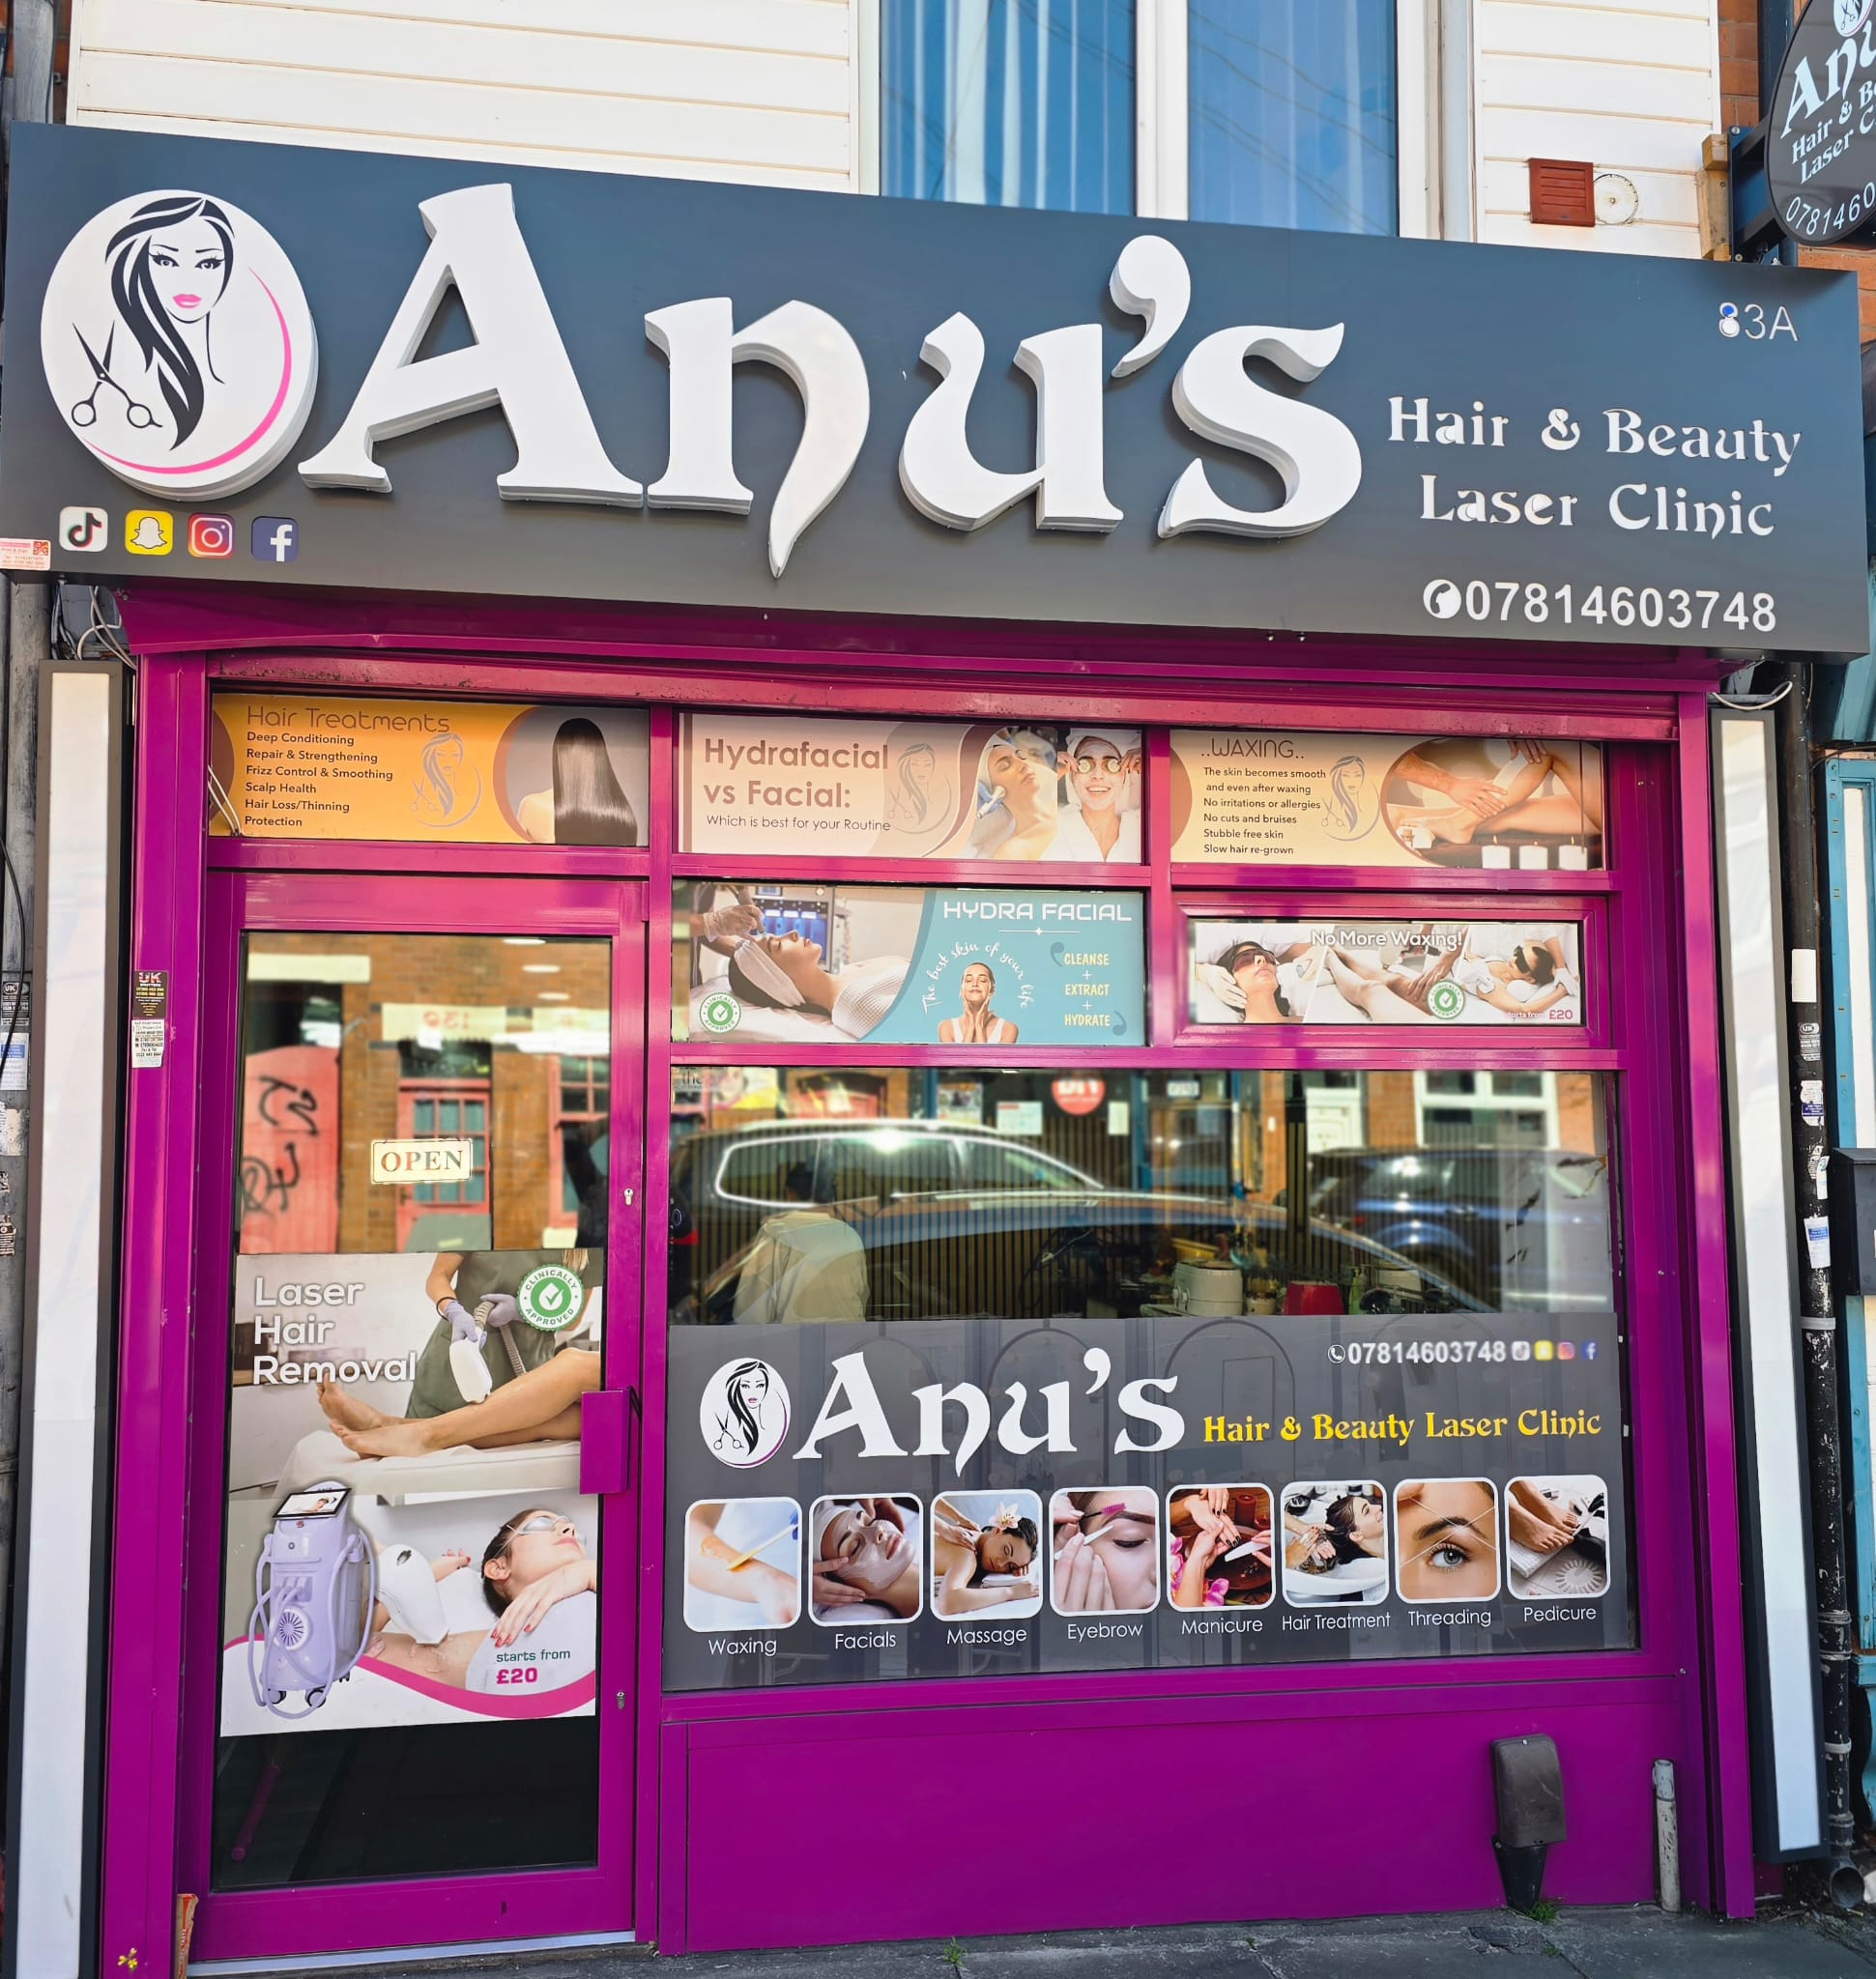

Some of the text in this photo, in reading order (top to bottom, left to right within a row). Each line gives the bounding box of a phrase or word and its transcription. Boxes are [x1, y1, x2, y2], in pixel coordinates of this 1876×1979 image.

[1792, 118, 1833, 163] Hair
[1838, 100, 1853, 125] &
[1800, 129, 1854, 185] Laser
[1786, 182, 1875, 236] 0781460
[1719, 301, 1799, 342] 83A
[298, 183, 1362, 578] Anu's
[1388, 396, 1802, 477] Hair & Beauty
[1421, 473, 1775, 540] Laser Clinic
[1464, 580, 1777, 633] 07814603748
[247, 704, 450, 733] Hair Treatments
[246, 731, 355, 747] Deep Conditioning
[246, 748, 378, 764] Repair & Strengthening
[705, 737, 888, 770] Hydrafacial
[245, 764, 393, 782] Frizz Control & Smoothing
[1203, 766, 1326, 779] The skin becomes smooth
[245, 782, 317, 794] Scalp Health
[704, 780, 851, 808] vs Facial:
[1206, 782, 1225, 791] and
[1252, 783, 1275, 792] after
[1277, 784, 1312, 795] waxing
[245, 799, 350, 814] Hair Loss/Thinning
[1203, 797, 1218, 807] No
[1221, 798, 1266, 808] irritations
[1281, 799, 1321, 811] allergies
[245, 816, 303, 827] Protection
[707, 815, 891, 831] Which is best for your Routine
[1203, 813, 1218, 821] No
[1242, 815, 1260, 823] and
[1262, 814, 1297, 824] bruises
[1203, 828, 1284, 839] Stubble free skin
[1203, 844, 1294, 856] Slow hair re-grown
[942, 901, 1133, 922] HYDRA FACIAL
[1311, 930, 1462, 952] No More Waxing!
[1063, 953, 1110, 966] CLEANSE
[921, 940, 1035, 1014] The best skin of your life
[1064, 984, 1110, 996] EXTRACT
[1064, 1014, 1111, 1027] HYDRATE
[1548, 1009, 1573, 1020] £20
[380, 1149, 463, 1173] OPEN
[525, 1269, 578, 1291] CLINICALLY
[253, 1276, 364, 1307] Laser
[525, 1307, 574, 1326] APPROVED
[253, 1315, 335, 1346] Hair
[1347, 1340, 1508, 1364] 07814603748
[252, 1352, 418, 1386] Removal
[792, 1347, 1186, 1477] Anu's
[1202, 1408, 1602, 1447] Hair & Beauty Laser Clinic
[1282, 1611, 1392, 1631] Hair Treatment
[1407, 1608, 1491, 1628] Threading
[1523, 1605, 1597, 1622] Pedicure
[946, 1626, 1027, 1647] Massage
[1067, 1622, 1143, 1643] Eyebrow
[1181, 1618, 1263, 1636] Manicure
[708, 1636, 778, 1656] Waxing
[834, 1630, 897, 1649] Facials
[495, 1648, 571, 1663] starts from
[496, 1666, 538, 1685] £20
